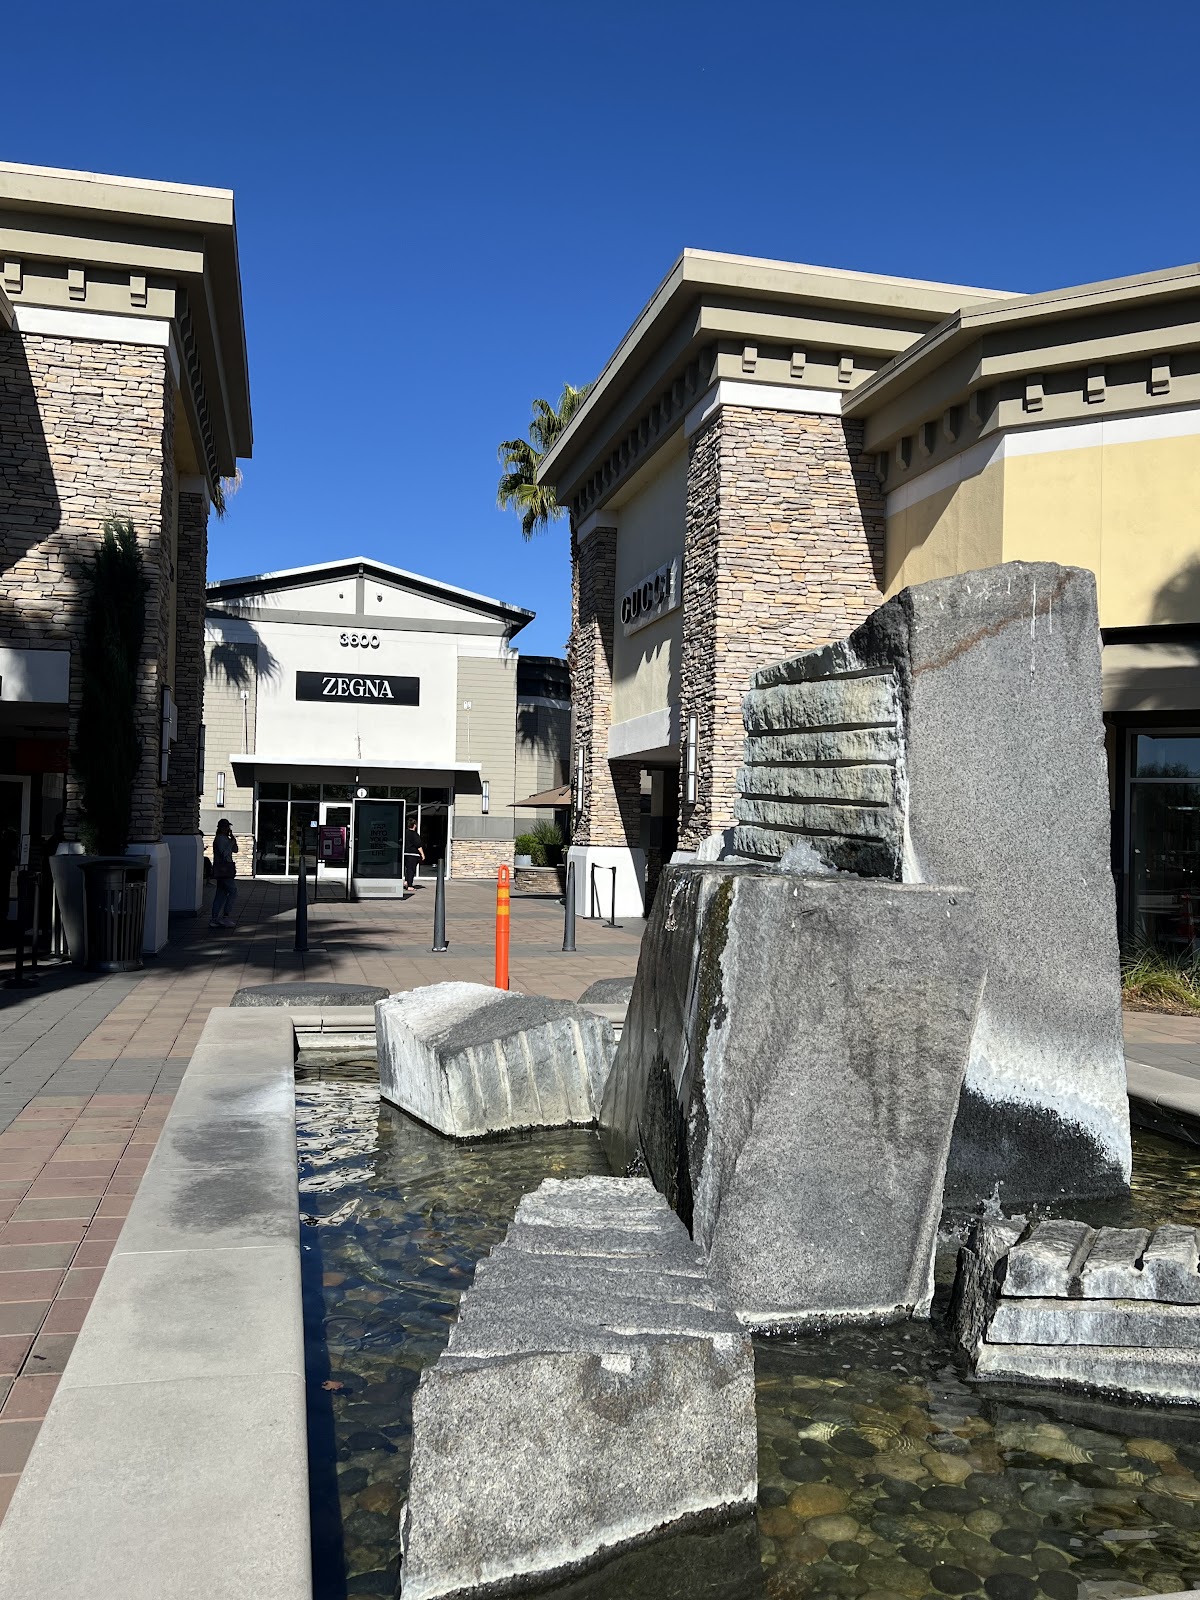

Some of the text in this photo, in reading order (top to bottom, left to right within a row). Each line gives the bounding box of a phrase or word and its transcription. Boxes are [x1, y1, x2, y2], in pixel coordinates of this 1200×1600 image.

[621, 568, 671, 624] GUCCI
[339, 632, 380, 649] 3600
[322, 677, 394, 698] ZEGNA
